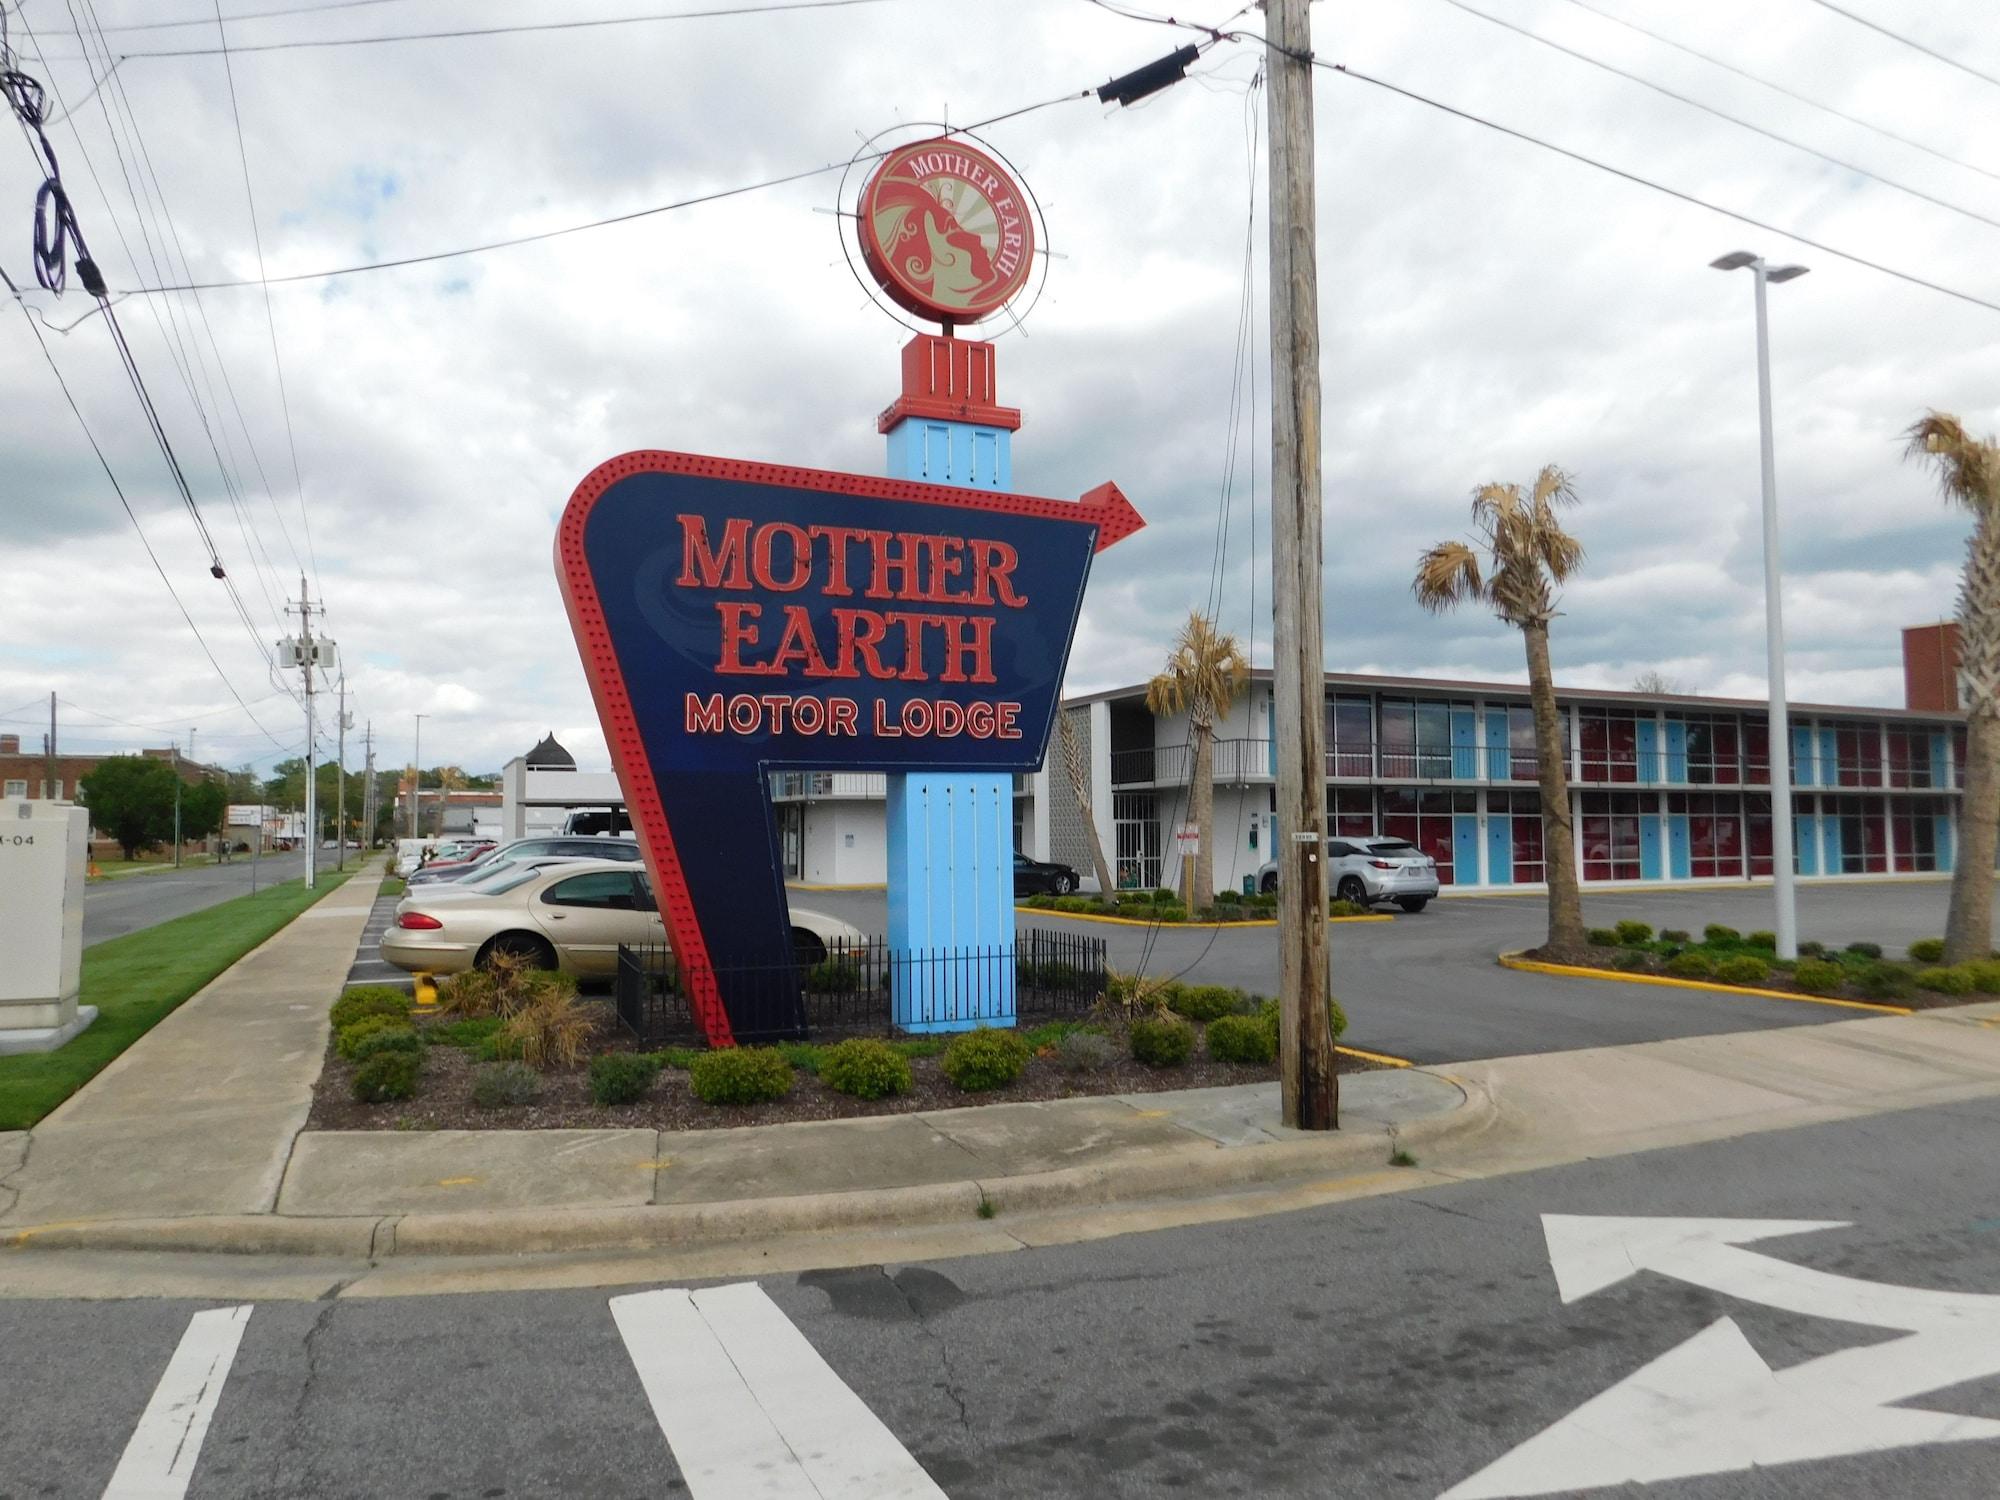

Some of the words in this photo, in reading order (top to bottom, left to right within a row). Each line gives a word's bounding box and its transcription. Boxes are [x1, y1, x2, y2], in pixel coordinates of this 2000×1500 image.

[908, 152, 1000, 198] MOTHER
[995, 197, 1023, 279] EARTH
[675, 513, 1029, 608] MOTHER
[714, 601, 997, 684] EARTH
[685, 692, 859, 737] MOTOR
[874, 698, 1023, 740] LODGE
